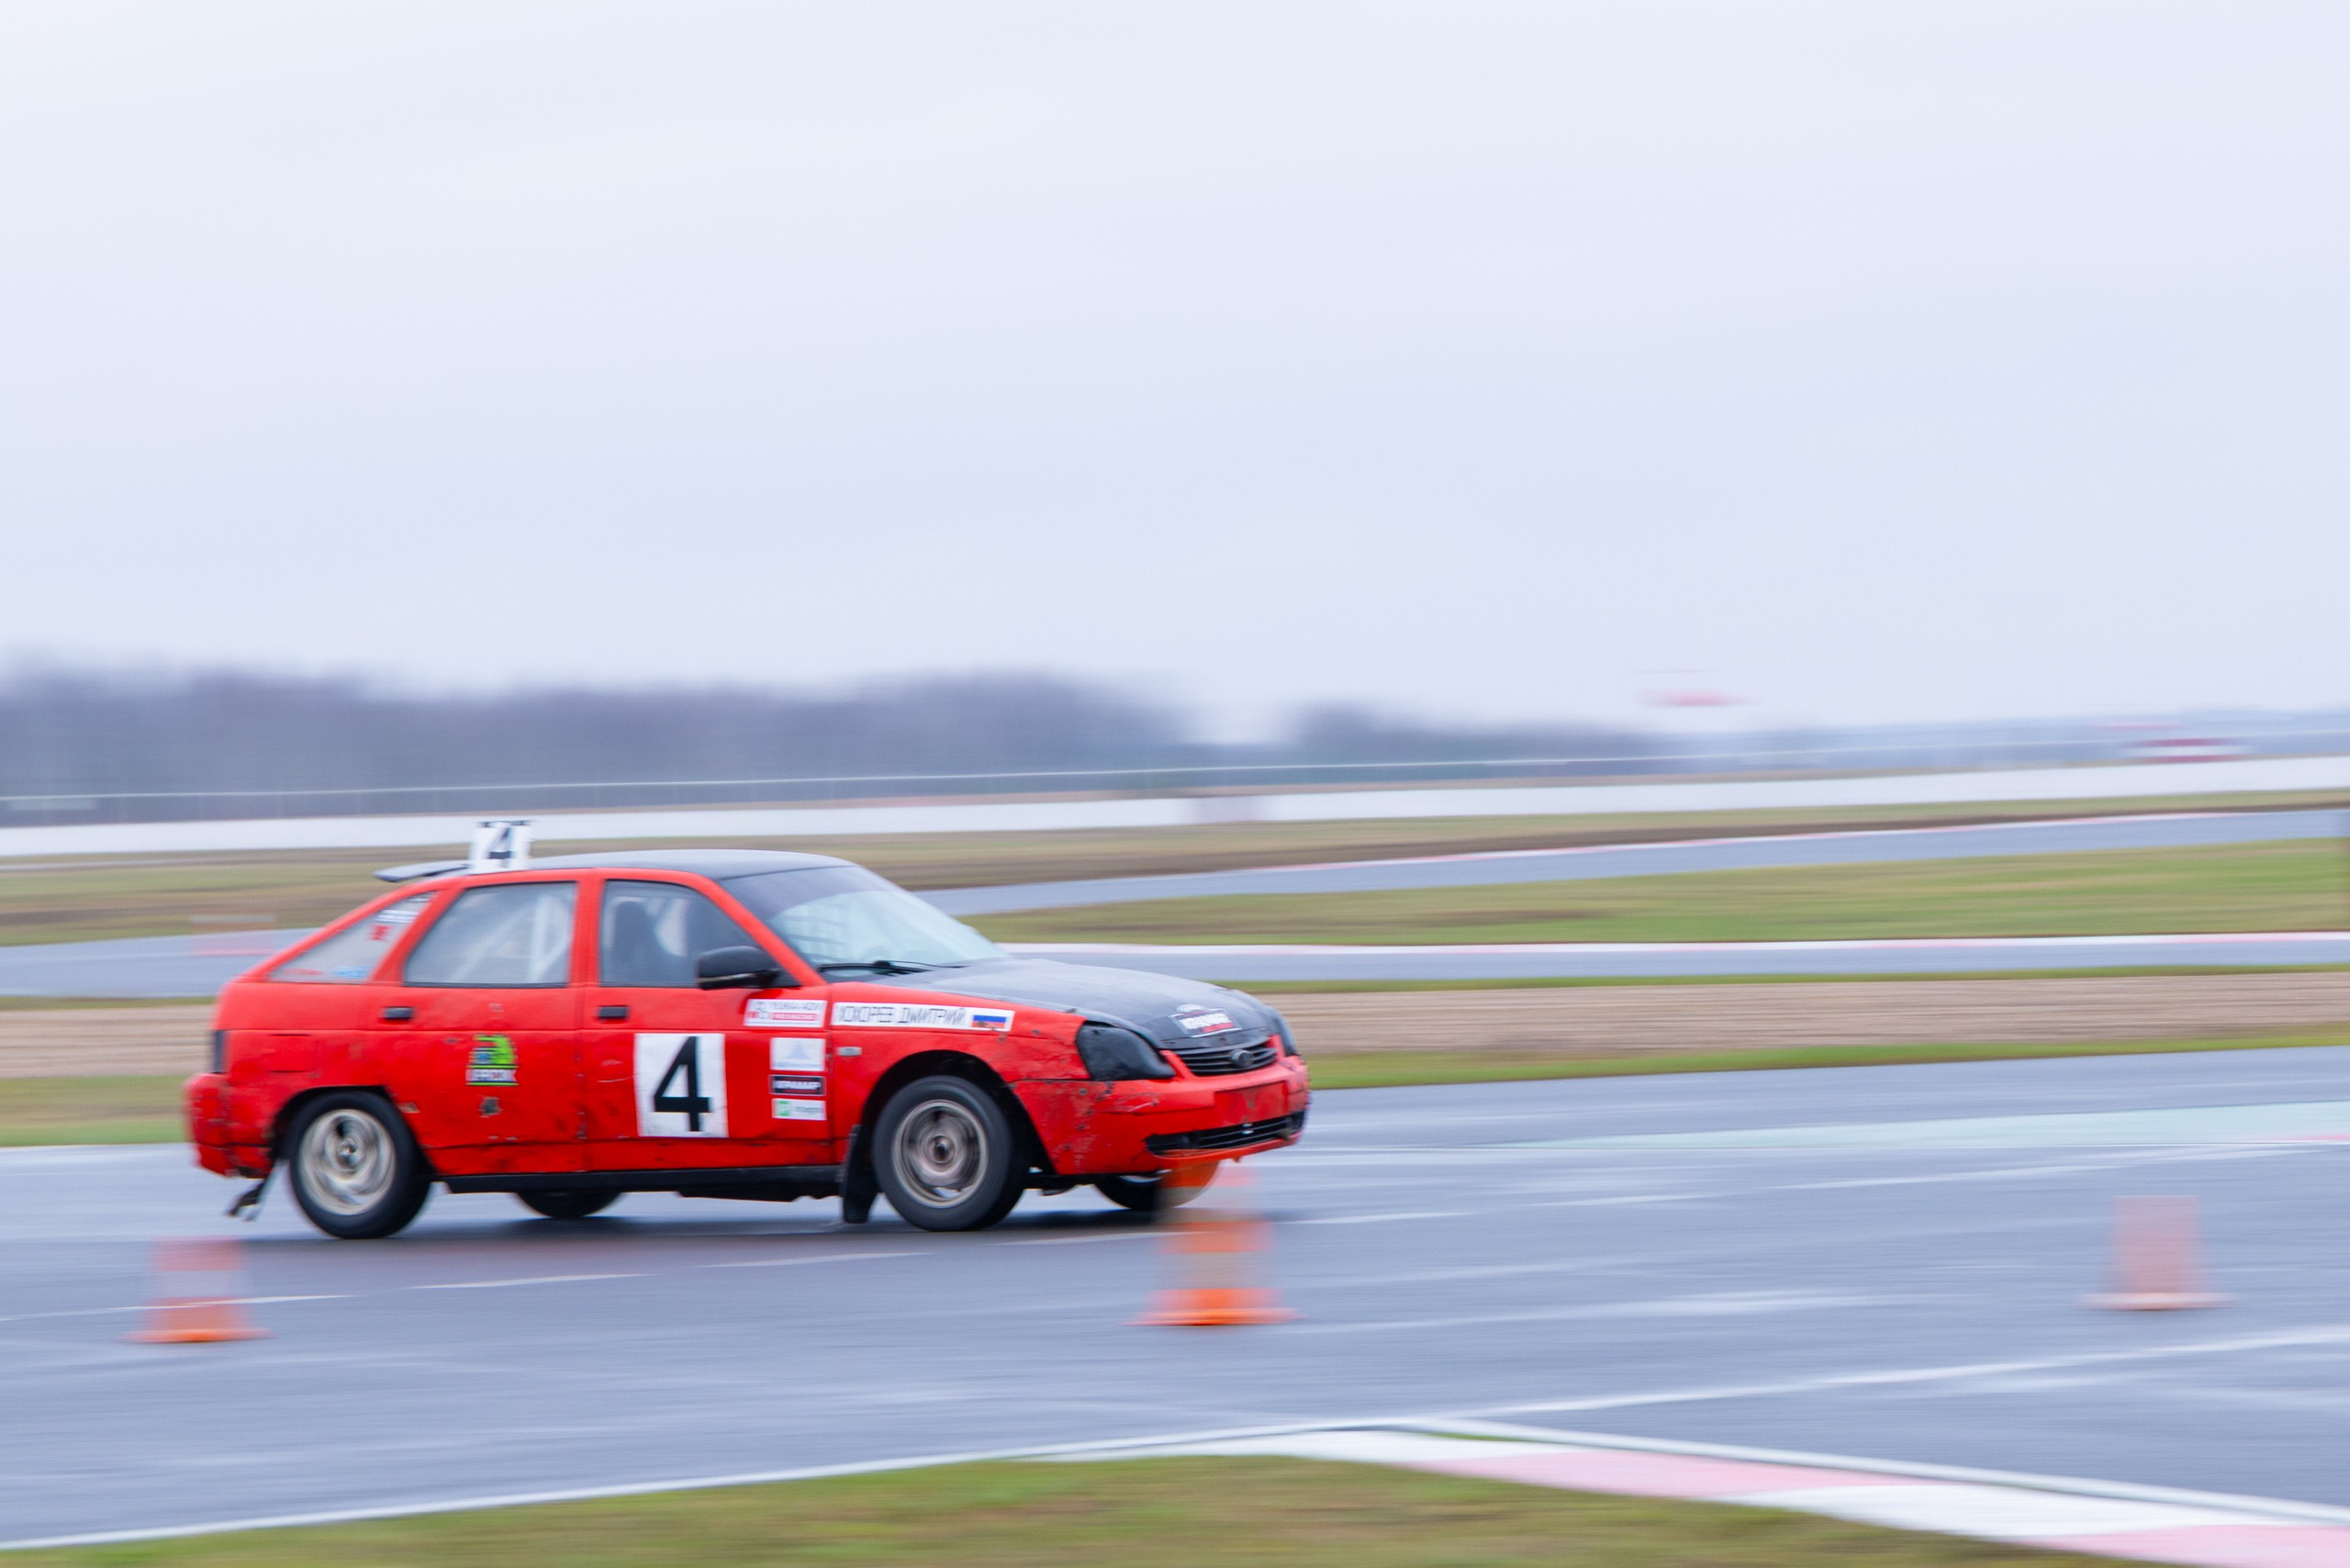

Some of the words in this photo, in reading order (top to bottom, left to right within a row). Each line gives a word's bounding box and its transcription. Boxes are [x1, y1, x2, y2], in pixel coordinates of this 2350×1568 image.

[487, 827, 516, 868] 4
[897, 1006, 967, 1026] ДМИТРИЙ
[653, 1036, 712, 1132] 4
